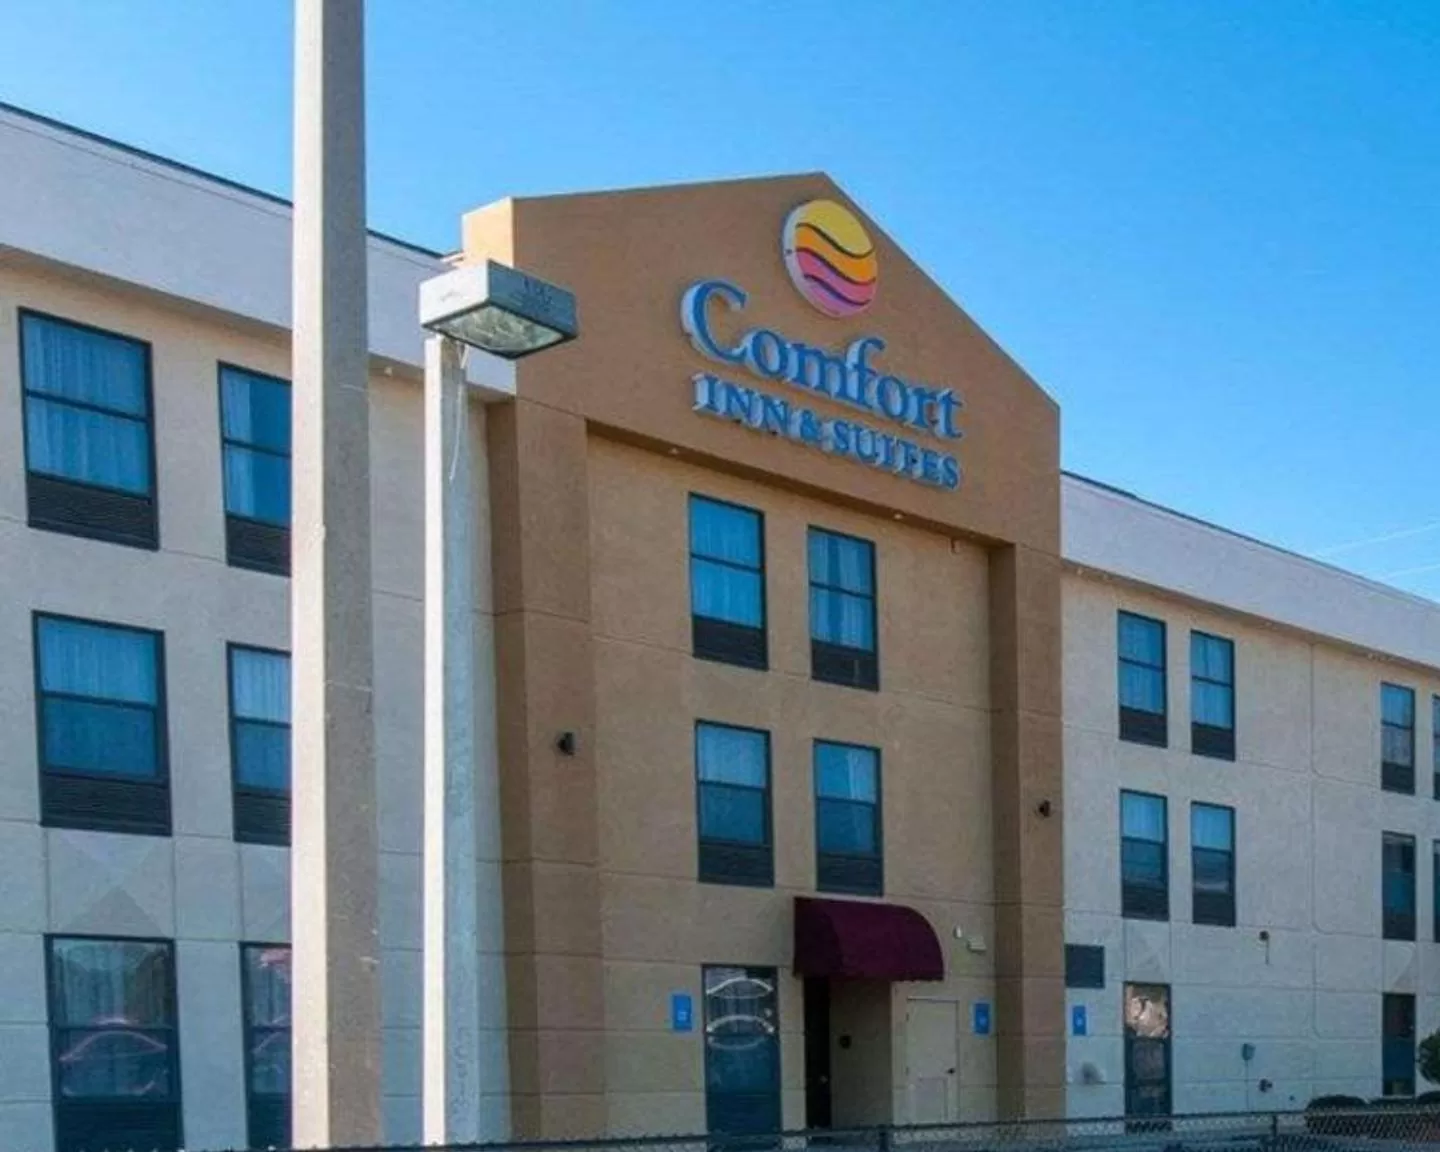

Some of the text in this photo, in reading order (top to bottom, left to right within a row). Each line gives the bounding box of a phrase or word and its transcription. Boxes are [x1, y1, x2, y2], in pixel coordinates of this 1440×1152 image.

[680, 279, 963, 441] Comfort
[691, 373, 790, 438] INN
[823, 417, 961, 491] SUITES
